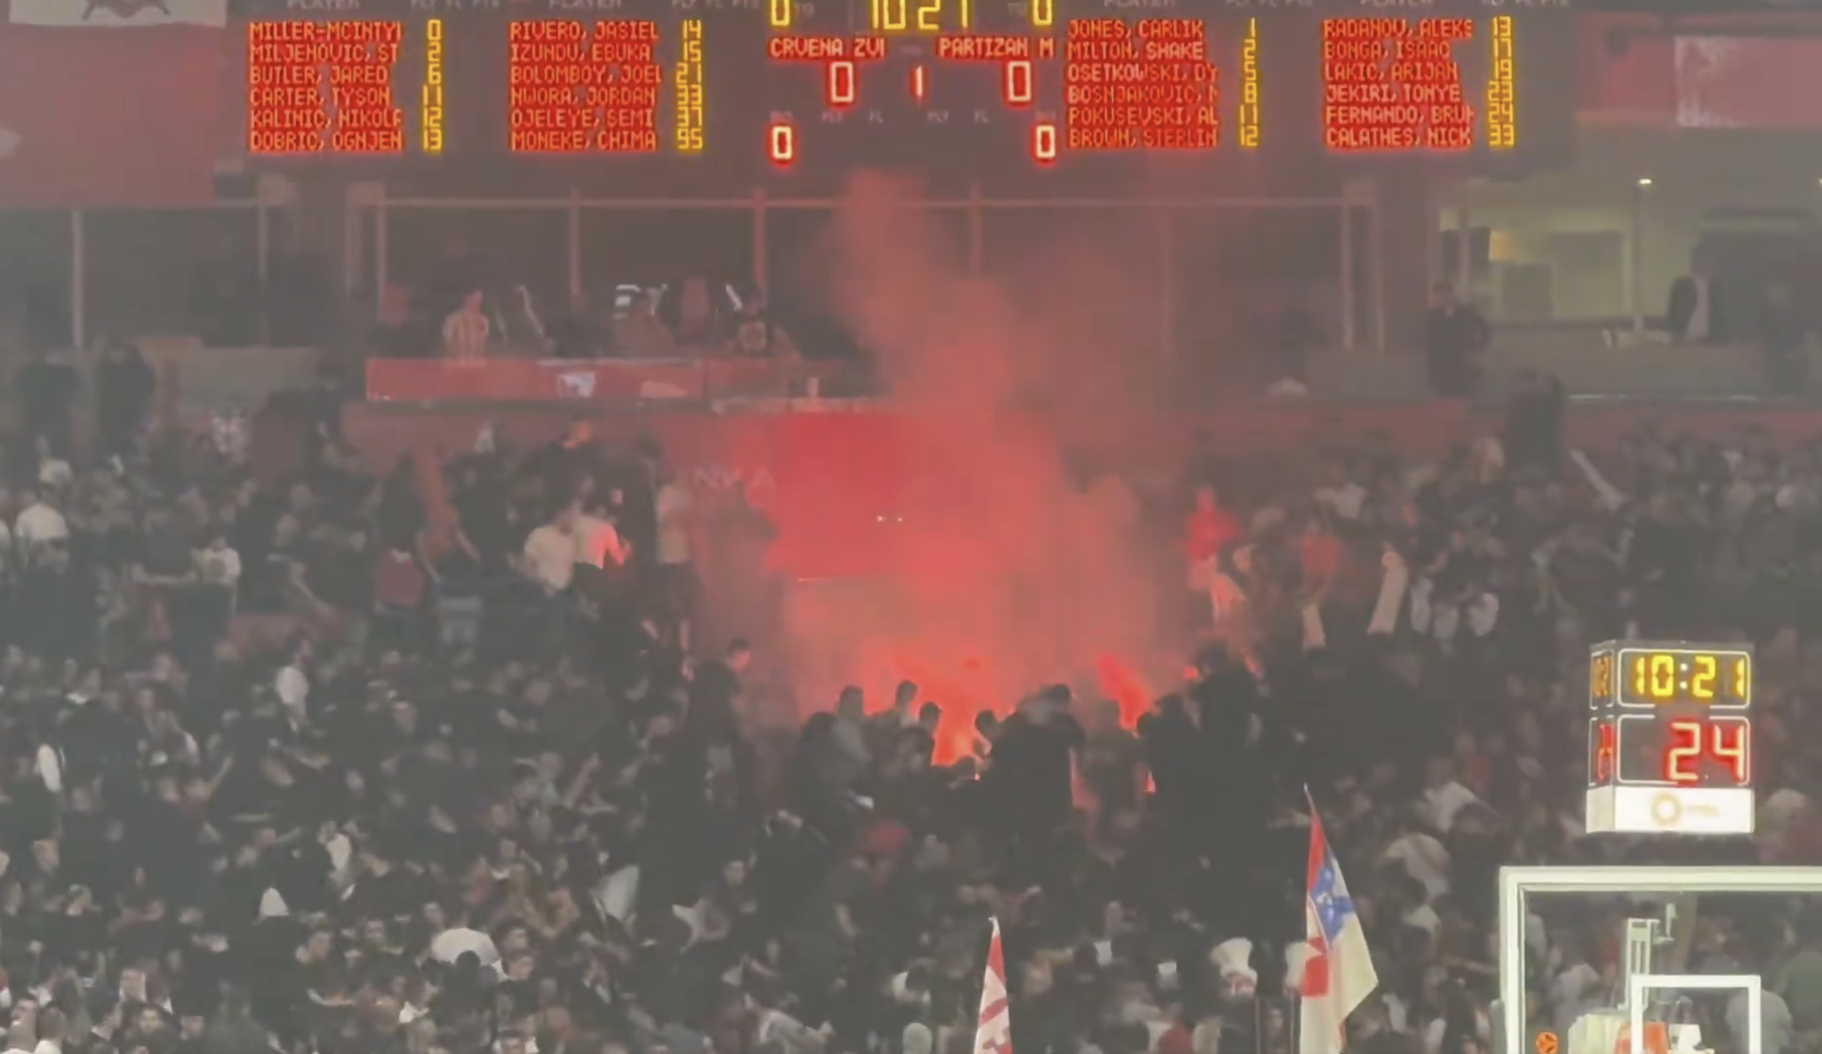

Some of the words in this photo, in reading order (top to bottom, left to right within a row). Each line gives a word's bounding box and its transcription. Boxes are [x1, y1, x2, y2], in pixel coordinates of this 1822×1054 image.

[250, 21, 402, 41] MILLER-MCINTY
[428, 19, 441, 41] 0
[510, 21, 587, 40] RIVERO,
[594, 20, 659, 40] JASIEL
[683, 19, 701, 39] 14
[1067, 19, 1132, 39] JONES,
[1138, 19, 1203, 39] CARLIK
[1250, 17, 1256, 38] 1
[1323, 18, 1413, 38] RADANOV,
[1493, 16, 1511, 36] 13
[250, 43, 371, 63] MILJENOVIC,
[428, 42, 441, 62] 2
[511, 43, 586, 62] IZUNDU,
[592, 42, 651, 62] EBUKA
[684, 40, 701, 62] 15
[770, 37, 844, 58] CRVENA
[939, 37, 1028, 58] PARTIZAN
[1067, 41, 1139, 60] MILTON,
[1145, 41, 1203, 60] SHAKE
[1244, 39, 1256, 60] 2
[1325, 40, 1388, 59] BONGA,
[1493, 37, 1511, 58] 17
[251, 65, 323, 85] BUTLER,
[331, 65, 388, 84] JARED
[428, 63, 441, 83] 6
[511, 65, 614, 84] BOLOMBOY,
[620, 64, 662, 83] JOEL
[676, 62, 701, 84] 21
[1068, 62, 1188, 82] OSETKOWSKI,
[1245, 60, 1257, 81] 5
[1325, 62, 1384, 81] LAKIC,
[1391, 62, 1458, 81] ARIJAN
[1494, 59, 1512, 80] 19
[830, 61, 853, 103] 0
[915, 66, 922, 98] 1
[1008, 61, 1031, 102] 0
[1245, 82, 1257, 103] 8
[1327, 84, 1397, 103] JEKIRI,
[1404, 83, 1460, 102] TONYE
[1488, 81, 1513, 101] 23
[251, 87, 324, 107] CARTER,
[332, 87, 390, 106] TYSON
[423, 85, 442, 105] 11
[511, 86, 578, 105] NWORA,
[586, 86, 655, 105] JORDAN
[677, 84, 702, 106] 33
[250, 109, 331, 129] KALINIC,
[423, 106, 442, 128] 12
[511, 108, 599, 128] OJELEYE,
[607, 108, 653, 128] SEMI
[677, 106, 702, 128] 37
[1069, 106, 1191, 126] POKUSEVSKI,
[1198, 106, 1218, 125] AL
[1240, 104, 1258, 125] 11
[1327, 105, 1424, 125] FERNANDO,
[1488, 102, 1513, 123] 24
[250, 130, 324, 150] DOBRIC,
[332, 130, 402, 150] OGNJEN
[423, 128, 442, 151] 13
[511, 130, 590, 150] MONEKE,
[597, 130, 656, 150] CHIMA
[678, 128, 703, 150] 95
[772, 126, 792, 159] 0
[1036, 125, 1055, 158] 0
[1069, 128, 1136, 148] BROWN,
[1240, 125, 1258, 147] 12
[1327, 127, 1420, 147] CALATHES,
[1428, 126, 1472, 146] NICK
[1489, 124, 1515, 147] 33
[1636, 655, 1745, 697] 10:21
[1669, 722, 1745, 780] 24
